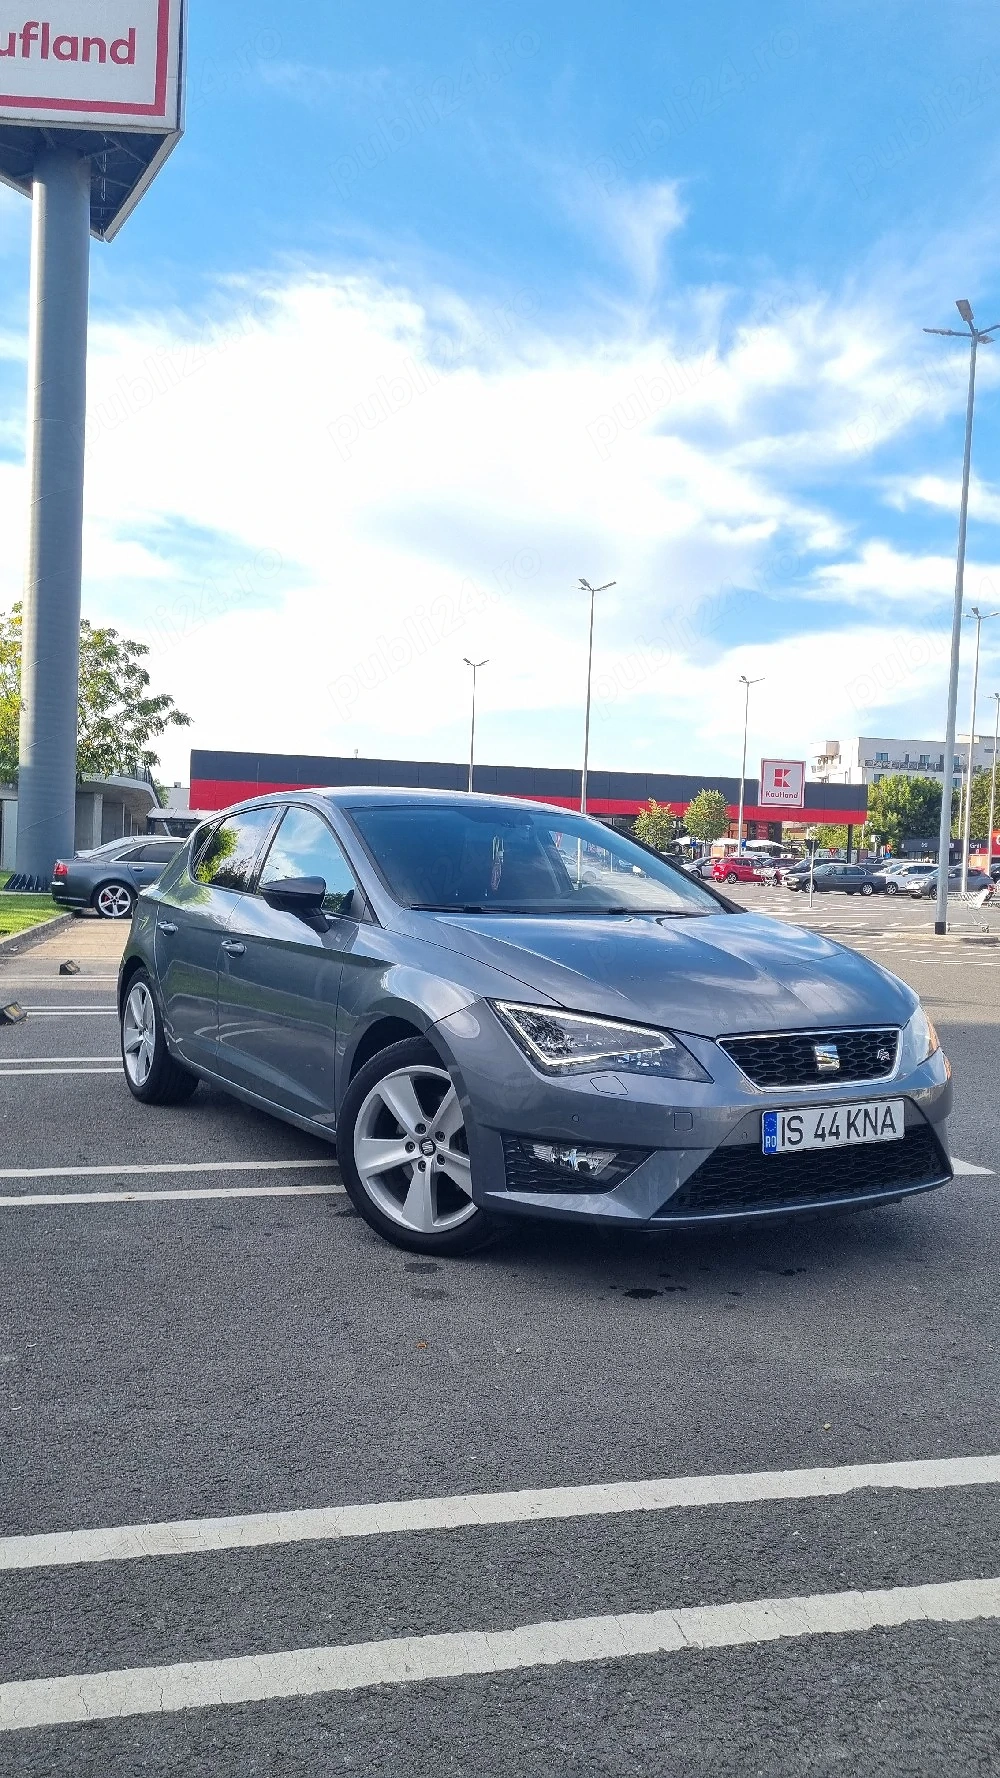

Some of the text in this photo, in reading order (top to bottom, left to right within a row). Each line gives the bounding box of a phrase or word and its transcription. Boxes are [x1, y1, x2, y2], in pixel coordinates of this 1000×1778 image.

[781, 1105, 897, 1146] IS 44 KNA
[765, 1135, 777, 1148] RO
